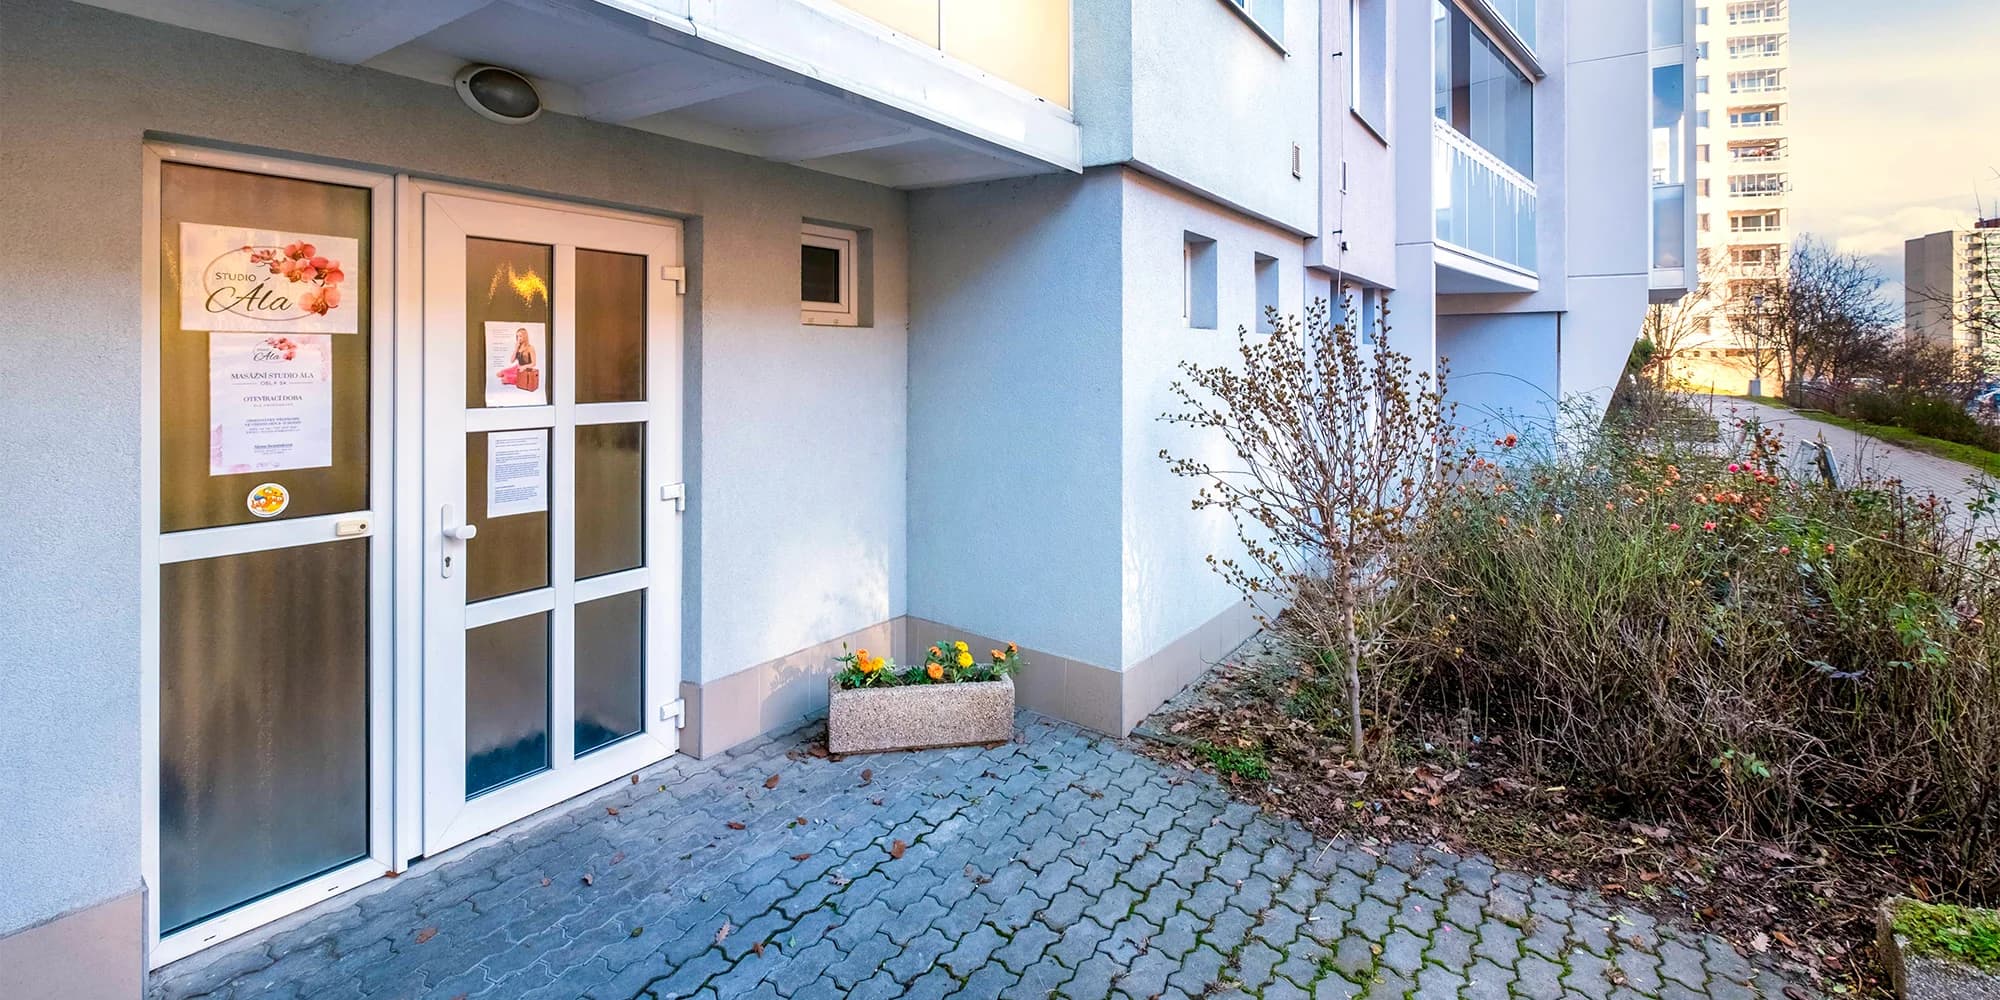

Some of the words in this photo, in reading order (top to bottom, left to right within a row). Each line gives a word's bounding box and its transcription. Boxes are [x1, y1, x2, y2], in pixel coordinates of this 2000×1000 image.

[215, 271, 257, 282] STUDIO
[205, 277, 293, 313] Ála
[268, 371, 298, 379] STUDIO
